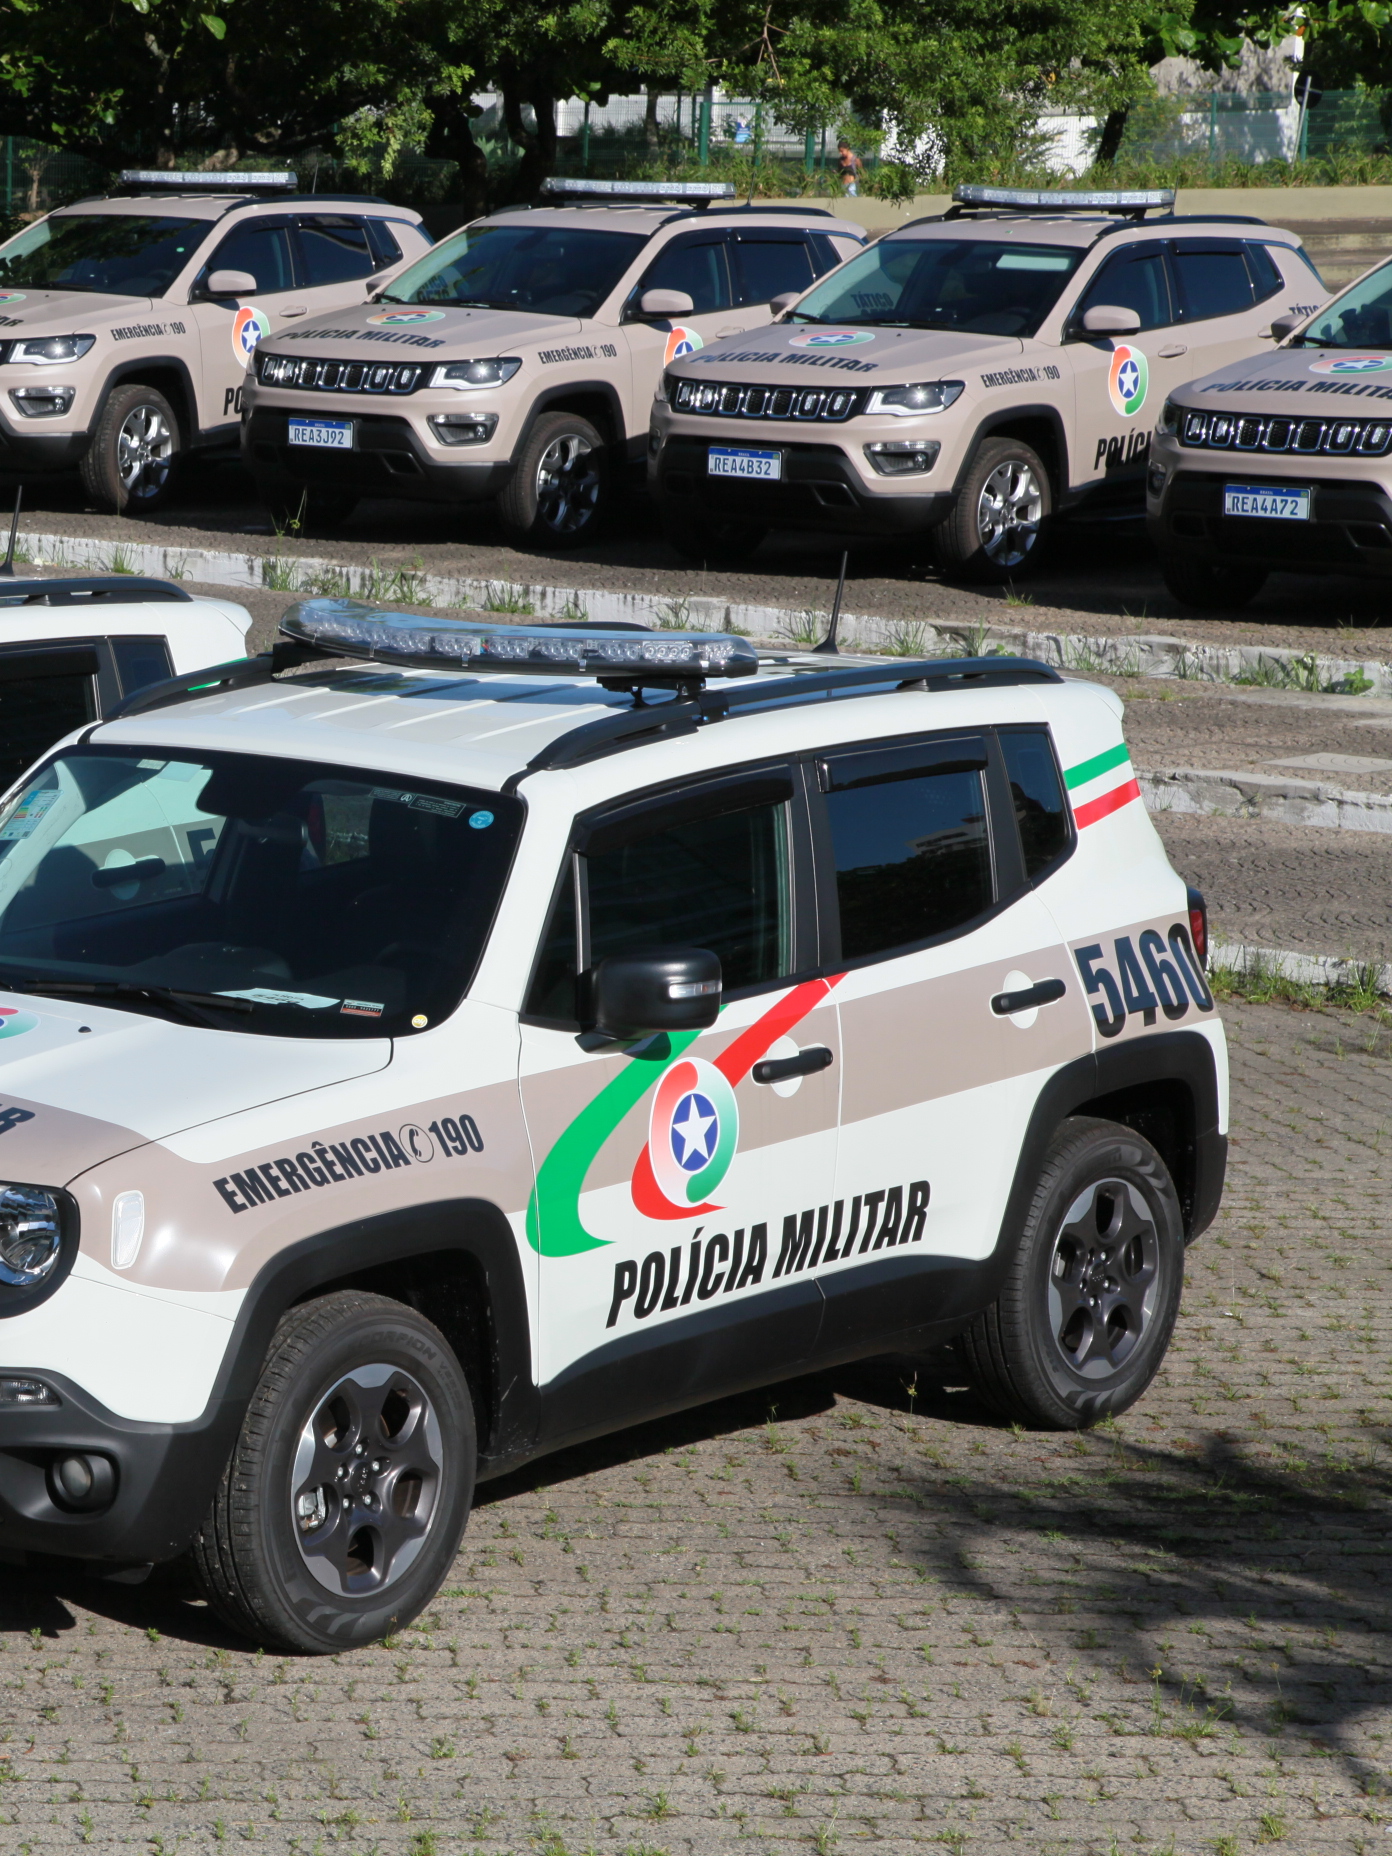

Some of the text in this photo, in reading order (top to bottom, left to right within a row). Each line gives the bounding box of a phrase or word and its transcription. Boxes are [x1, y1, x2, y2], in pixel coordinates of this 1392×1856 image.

[110, 321, 186, 341] EMERGÊNCIA 190
[276, 328, 447, 348] POLÍCIA MILITAR
[537, 344, 617, 364] EMERGÊNCIA 190
[689, 350, 879, 373] POLÍCIA MILITAR
[980, 365, 1061, 388] EMERGÊNCIA 190
[1199, 378, 1308, 392] POLÍCIA
[294, 427, 345, 445] REA3J92
[714, 457, 772, 476] REA4B32
[1231, 495, 1299, 516] REA4A72
[1073, 922, 1214, 1039] 5460
[212, 1114, 484, 1214] EMERGÊNCIA 190
[605, 1180, 931, 1329] POLÍCIA MILITAR
